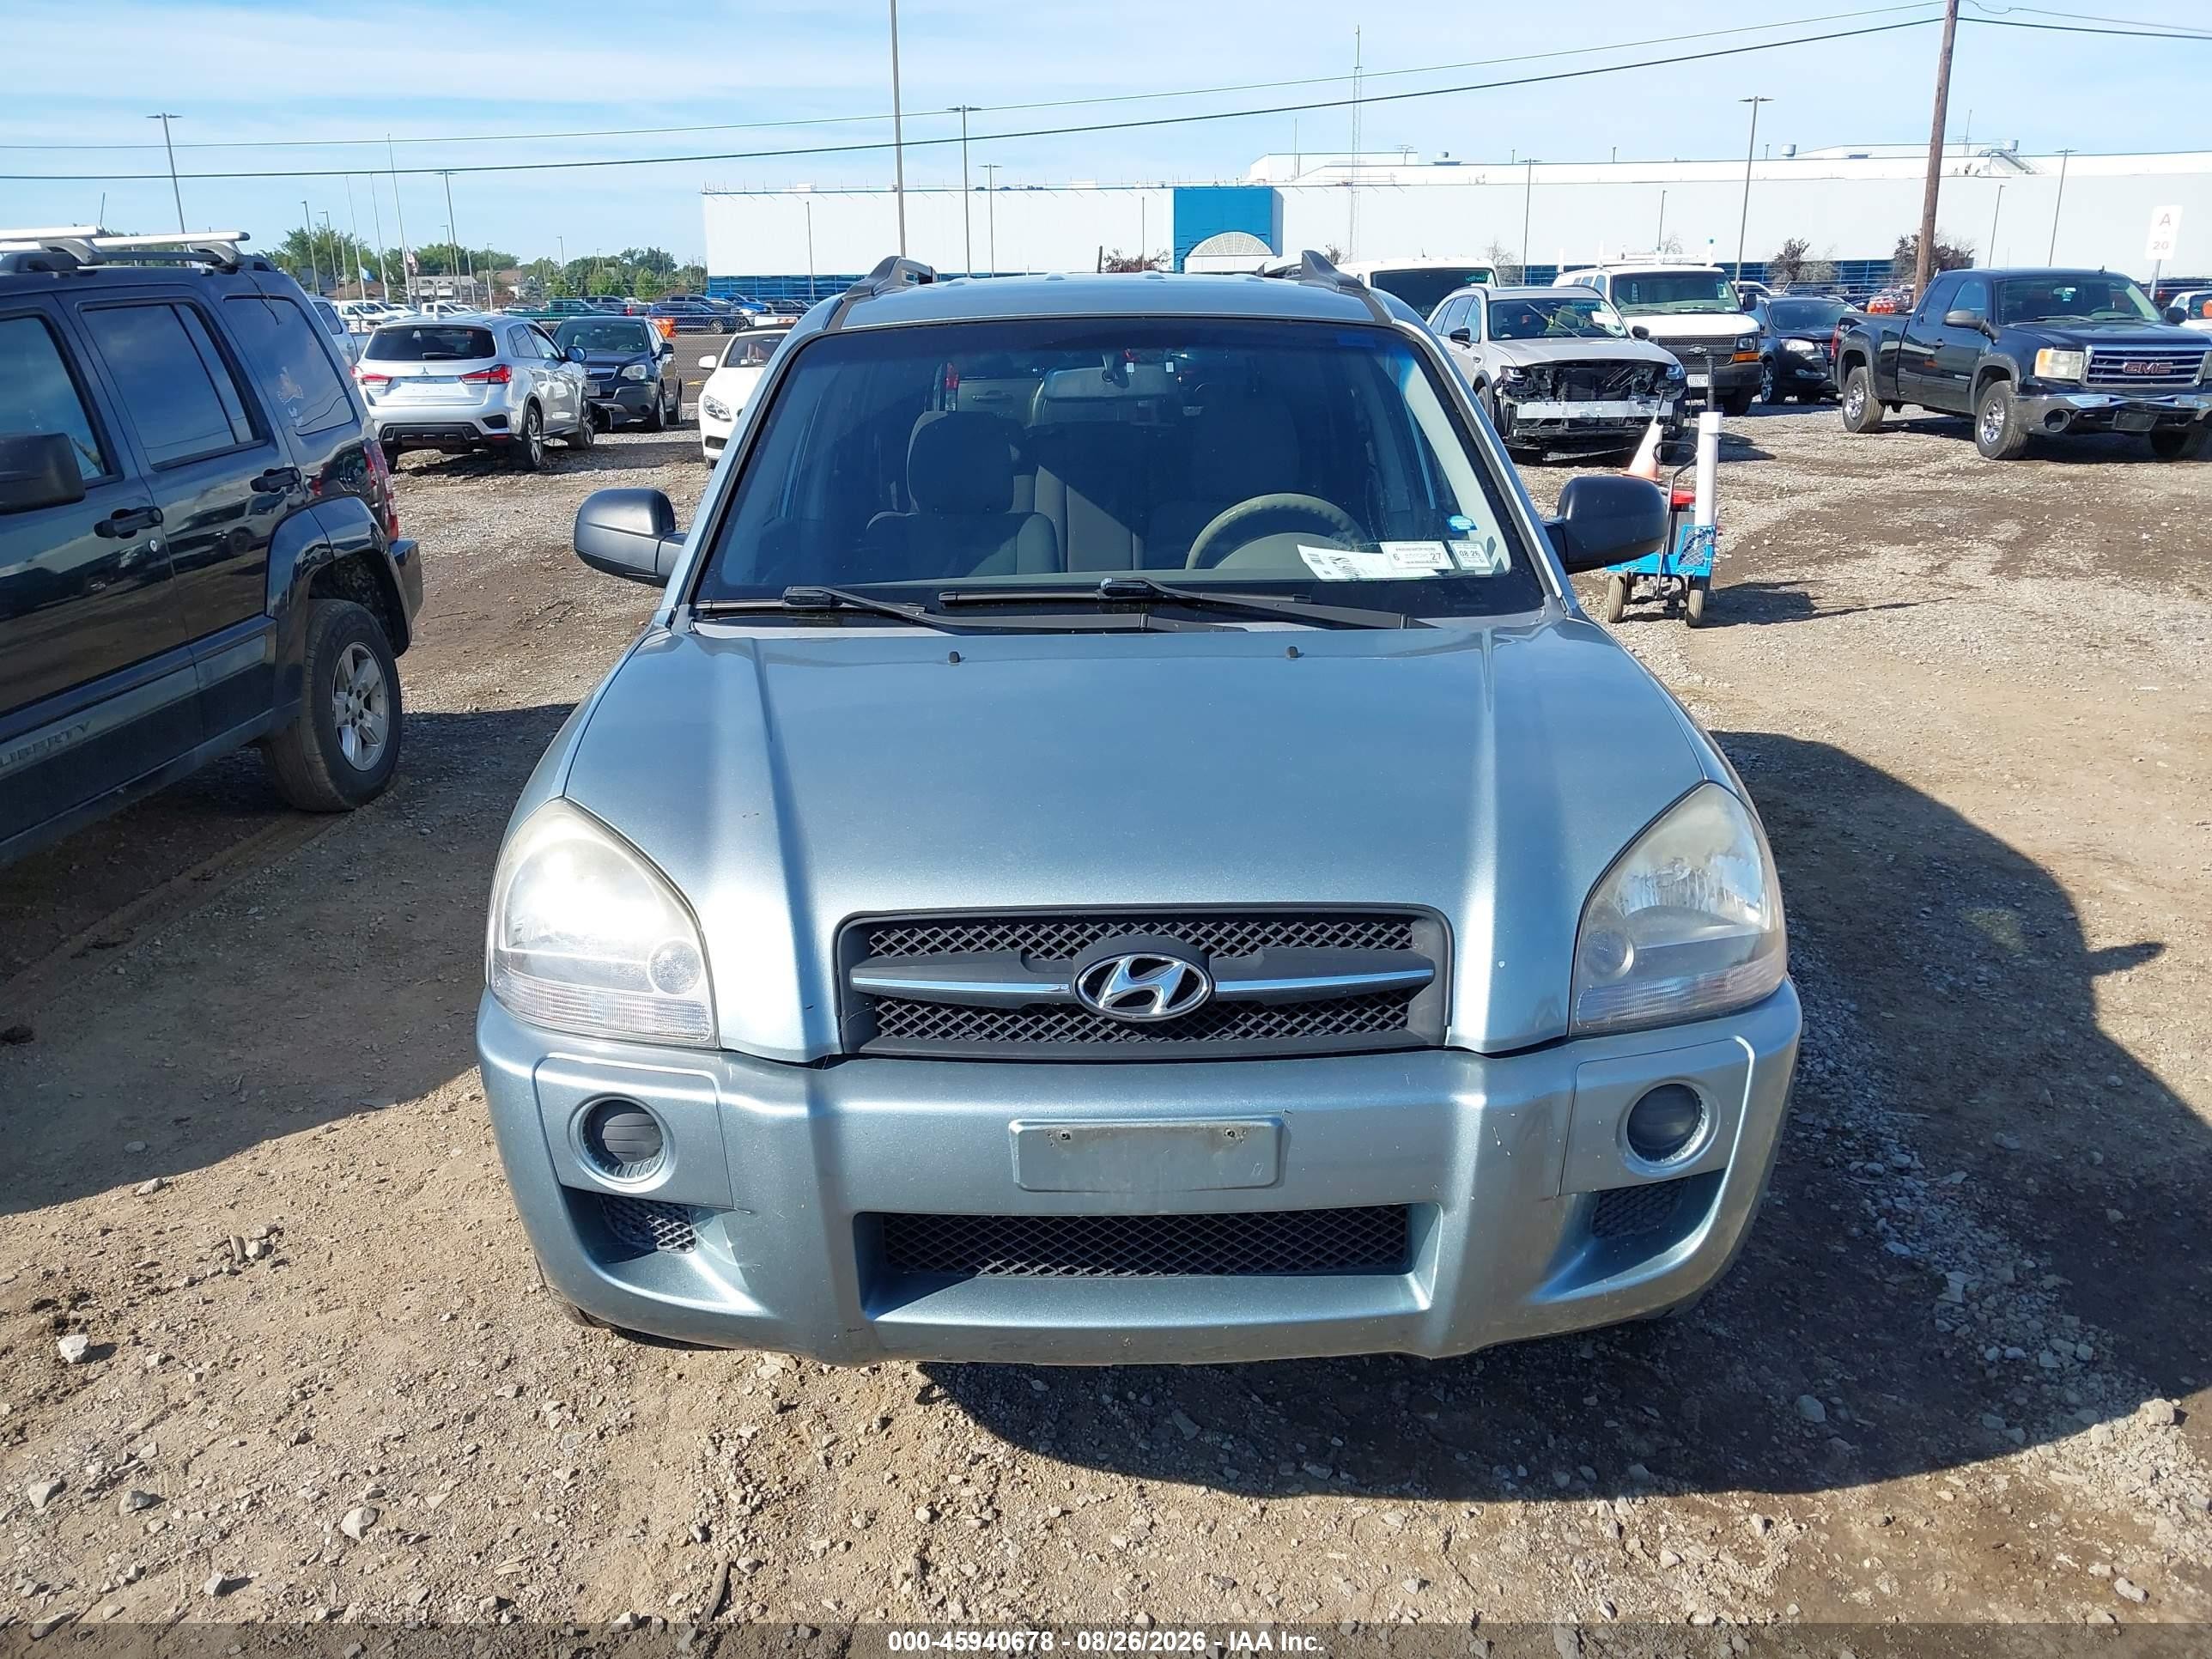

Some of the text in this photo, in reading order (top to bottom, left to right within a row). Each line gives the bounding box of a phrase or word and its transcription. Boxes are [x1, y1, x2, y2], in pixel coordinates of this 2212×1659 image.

[2159, 213, 2171, 226] A
[2153, 241, 2169, 250] 20
[2123, 362, 2173, 374] GMC
[1430, 552, 1442, 561] 27
